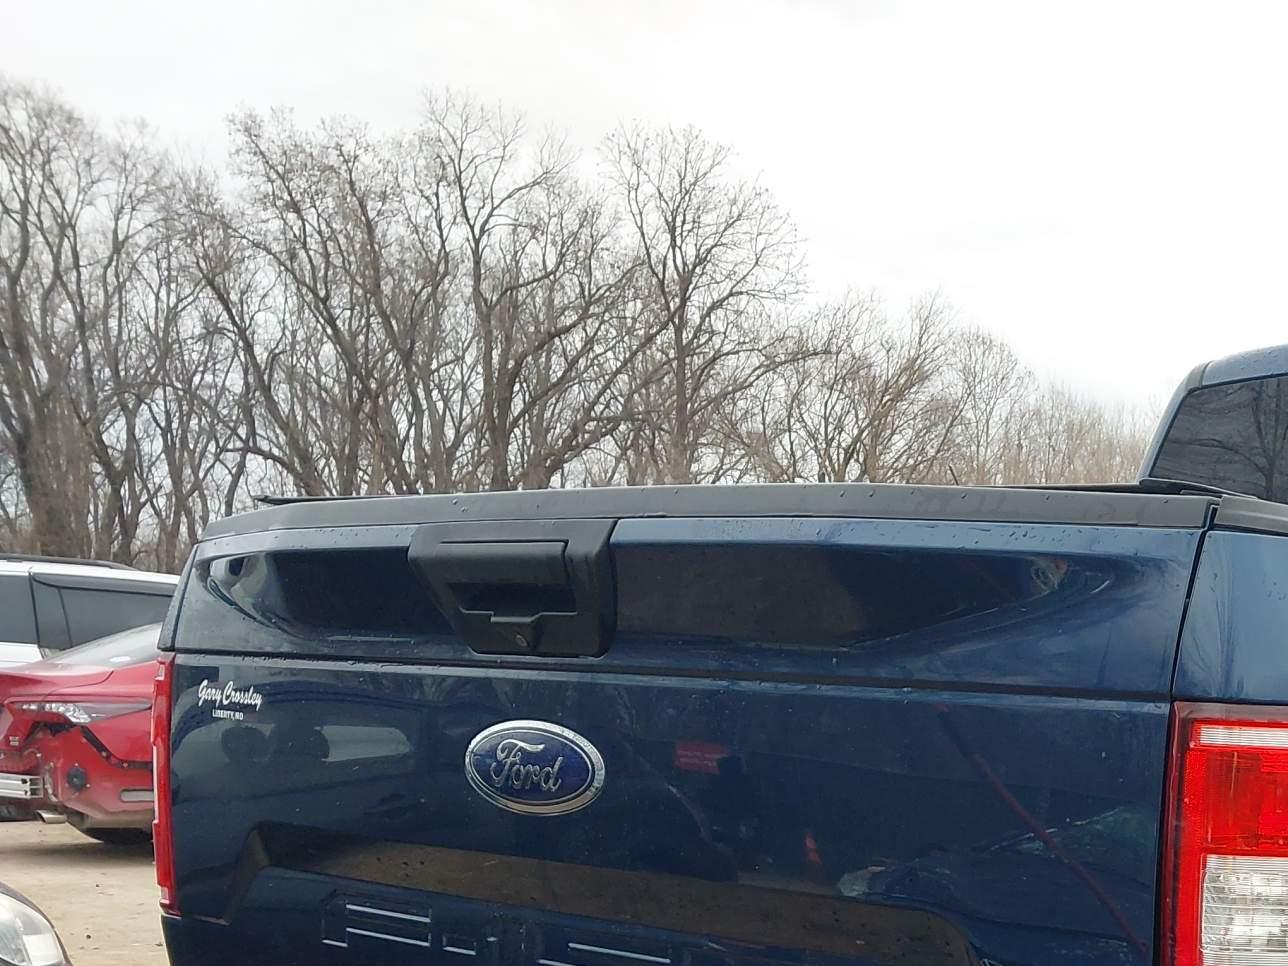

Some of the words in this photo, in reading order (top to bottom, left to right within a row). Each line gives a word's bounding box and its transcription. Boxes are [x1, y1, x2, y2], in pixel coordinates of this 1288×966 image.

[198, 679, 222, 707] Gary
[222, 681, 262, 711] Crossley
[489, 738, 564, 792] Ford
